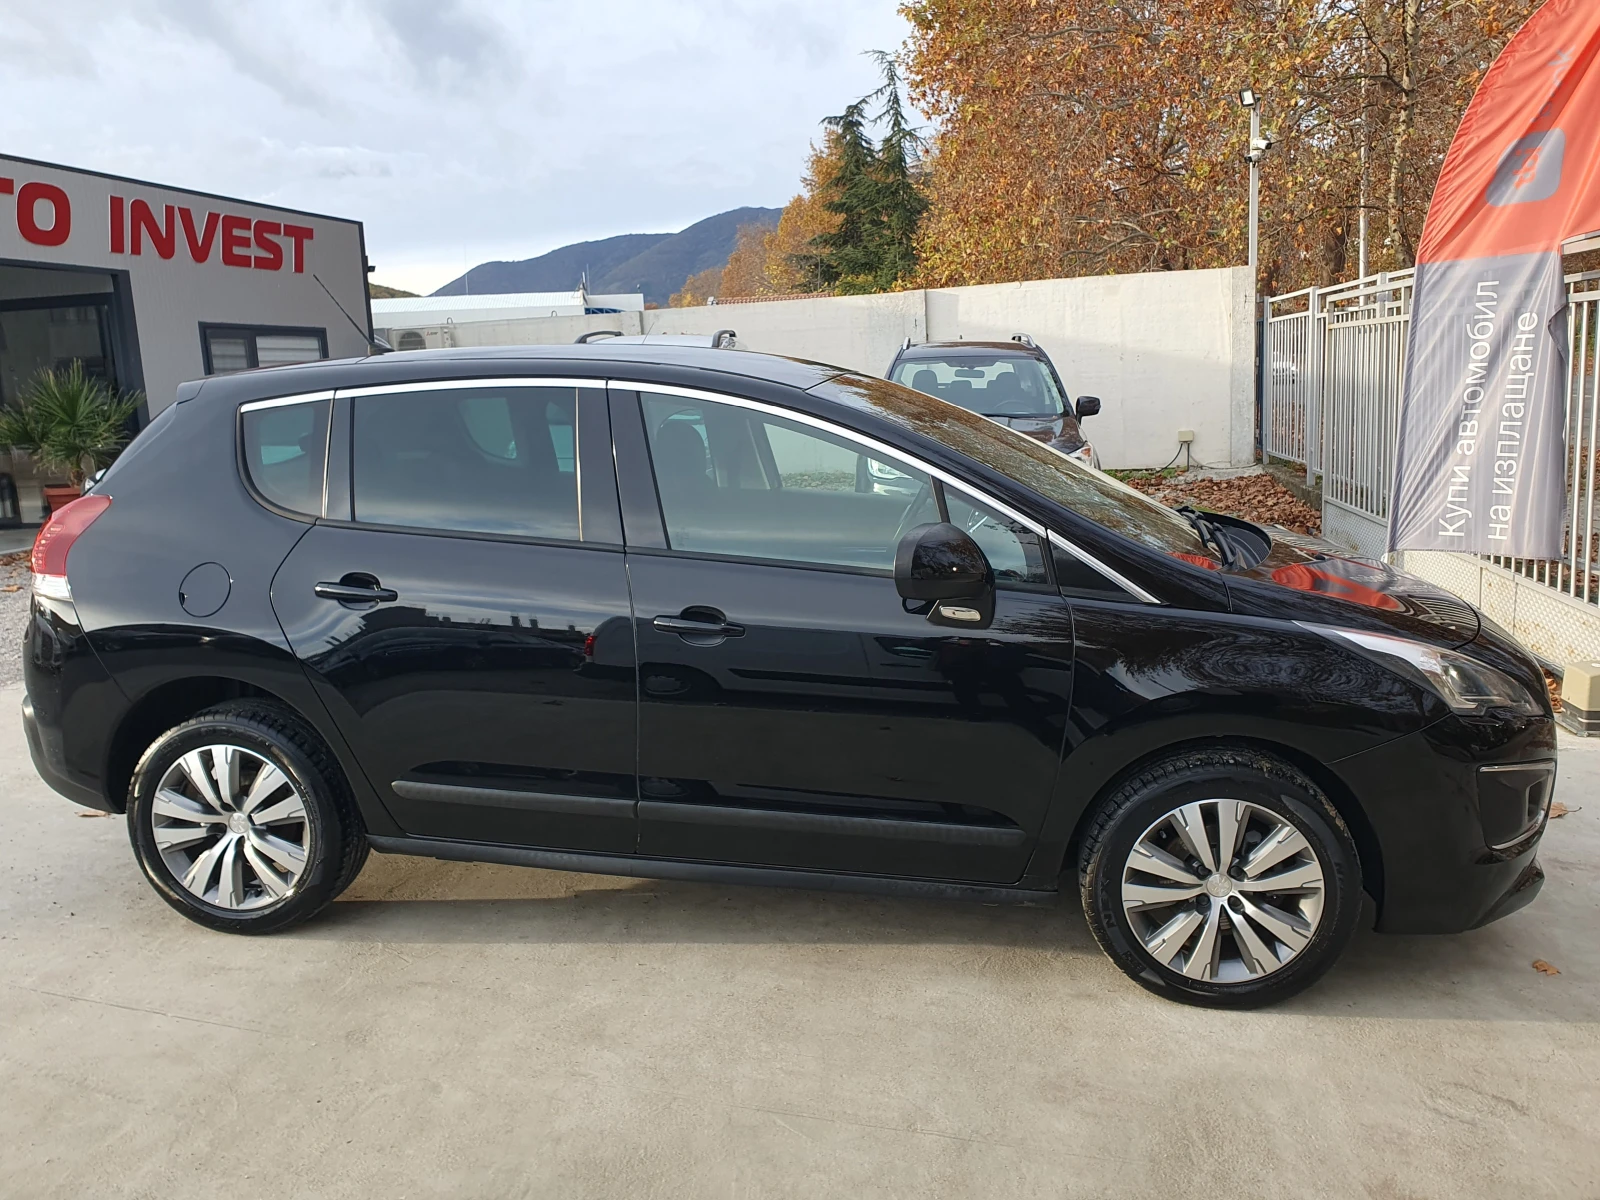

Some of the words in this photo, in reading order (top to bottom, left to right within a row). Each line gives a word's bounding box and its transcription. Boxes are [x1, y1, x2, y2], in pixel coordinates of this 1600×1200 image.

[109, 195, 314, 274] INVEST
[1438, 465, 1472, 537] Купи
[1456, 280, 1500, 456] автомобил
[1492, 311, 1539, 495] изплащане
[1488, 505, 1511, 540] на
